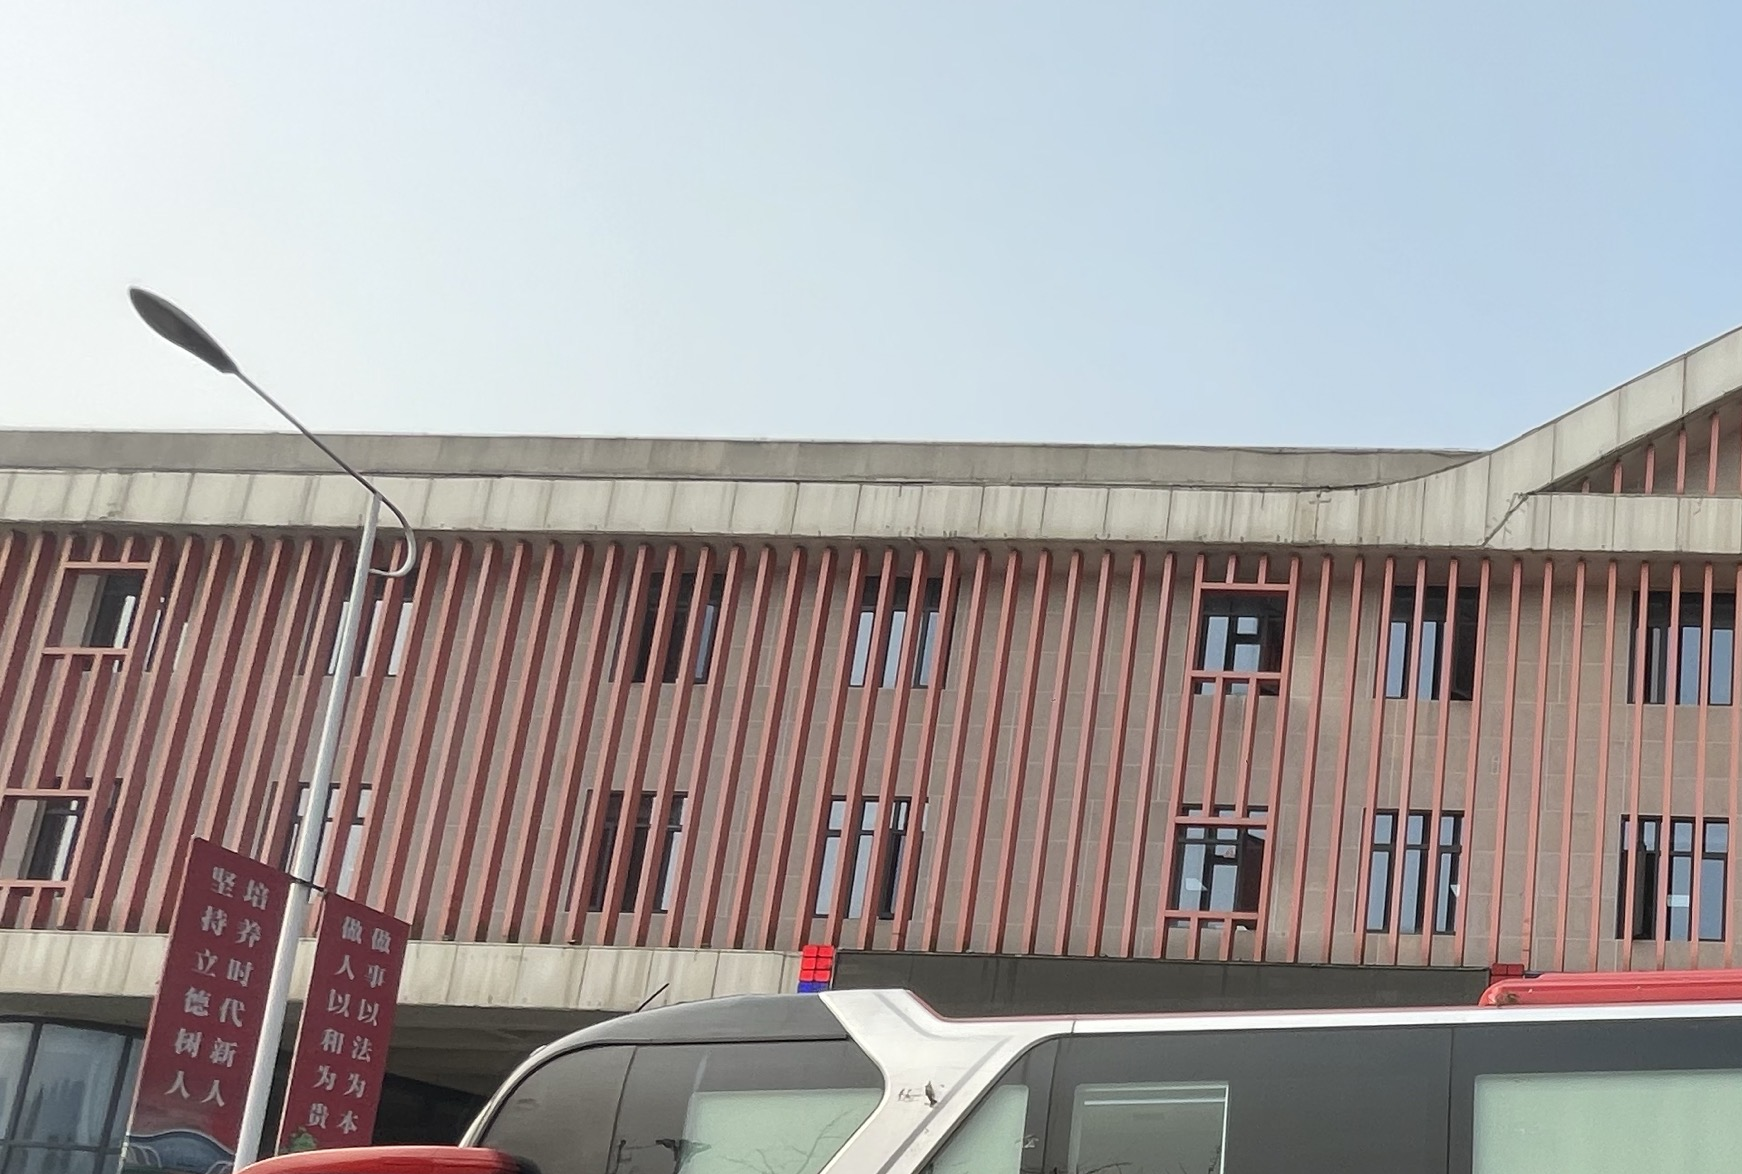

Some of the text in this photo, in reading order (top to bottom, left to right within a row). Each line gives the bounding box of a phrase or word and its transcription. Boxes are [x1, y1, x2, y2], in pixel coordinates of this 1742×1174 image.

[164, 866, 238, 1100] 坚持立德树人
[201, 879, 270, 1108] 培养时代新人
[306, 916, 362, 1130] 做人以和为贵
[336, 928, 392, 1135] 做事以法为本
